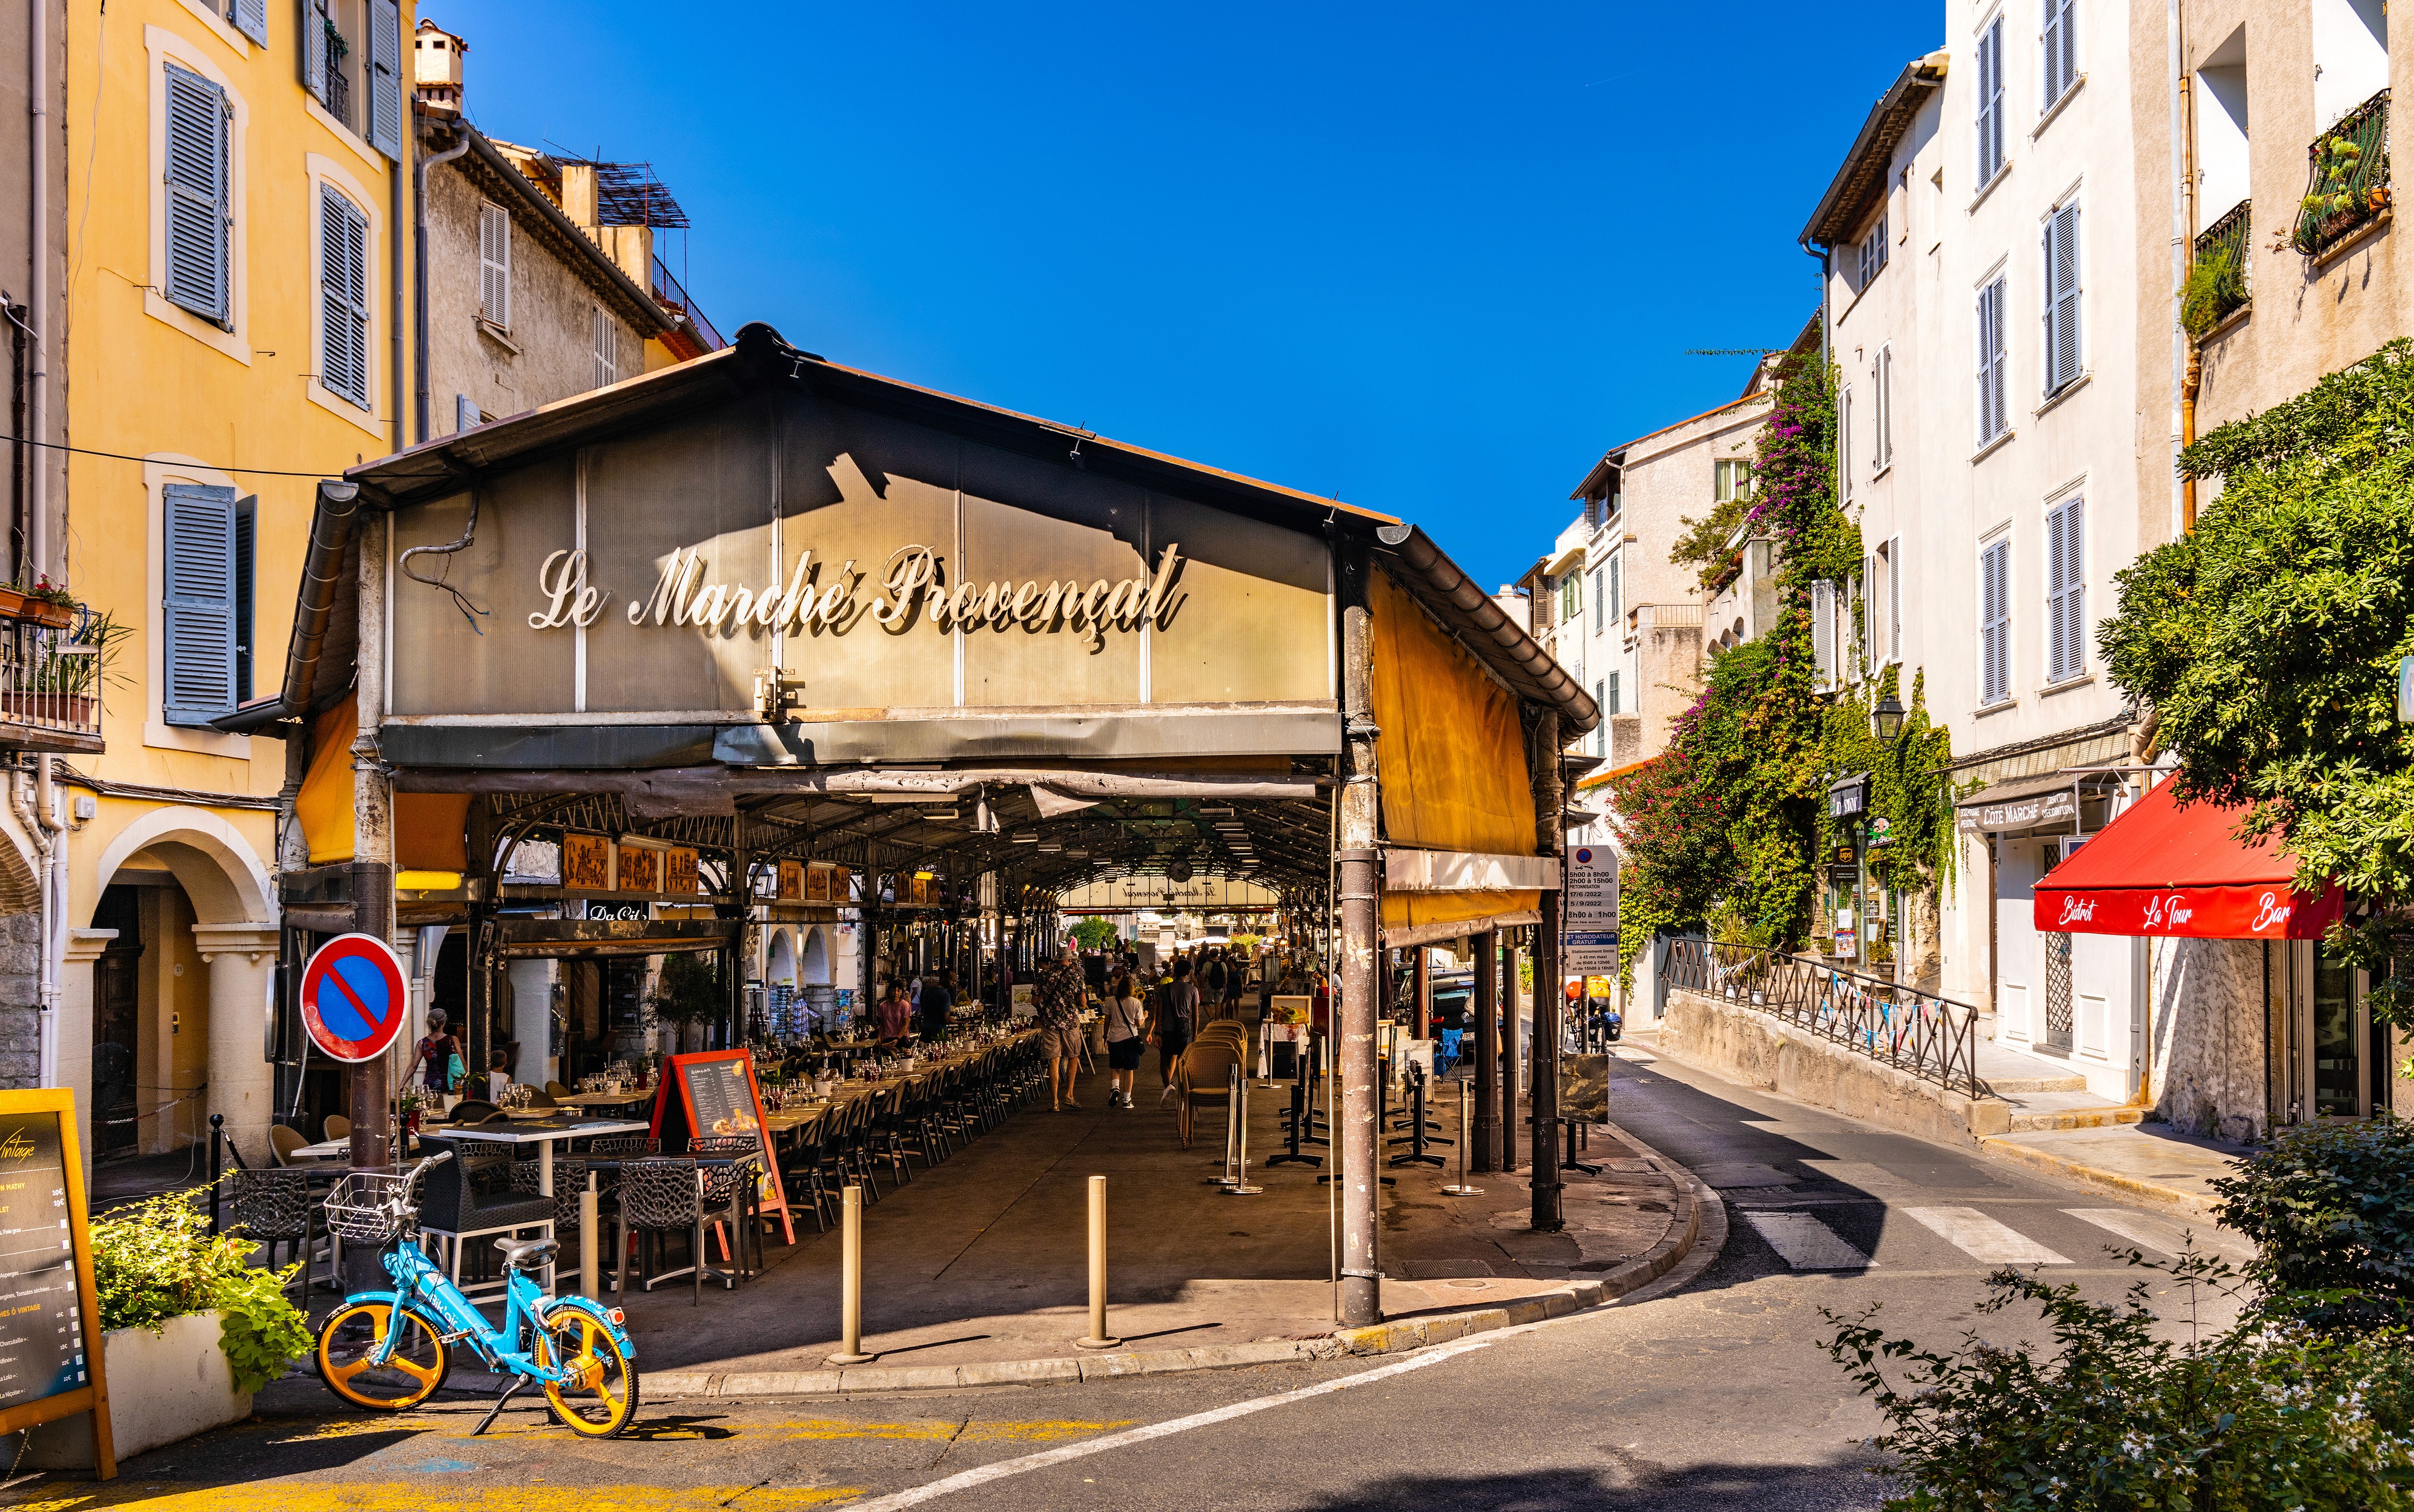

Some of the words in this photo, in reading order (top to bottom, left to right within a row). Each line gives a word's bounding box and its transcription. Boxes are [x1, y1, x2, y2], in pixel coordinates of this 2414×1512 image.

[529, 549, 600, 630] Le
[628, 546, 857, 627] Marché
[873, 543, 1180, 644] Provençal
[1836, 801, 1843, 815] D
[1983, 805, 2004, 825] CÔTÉ
[2005, 799, 2039, 824] MARCHÉ
[590, 905, 615, 920] Da
[2059, 895, 2099, 925] Bistrot
[2143, 895, 2163, 930] La
[2164, 895, 2193, 930] Tour
[2252, 891, 2291, 932] Bar
[6, 1182, 25, 1190] MATHY
[52, 1187, 63, 1196] 10€
[53, 1198, 65, 1207] 19€
[11, 1307, 16, 1315] Ô
[17, 1303, 41, 1313] VINTAGE
